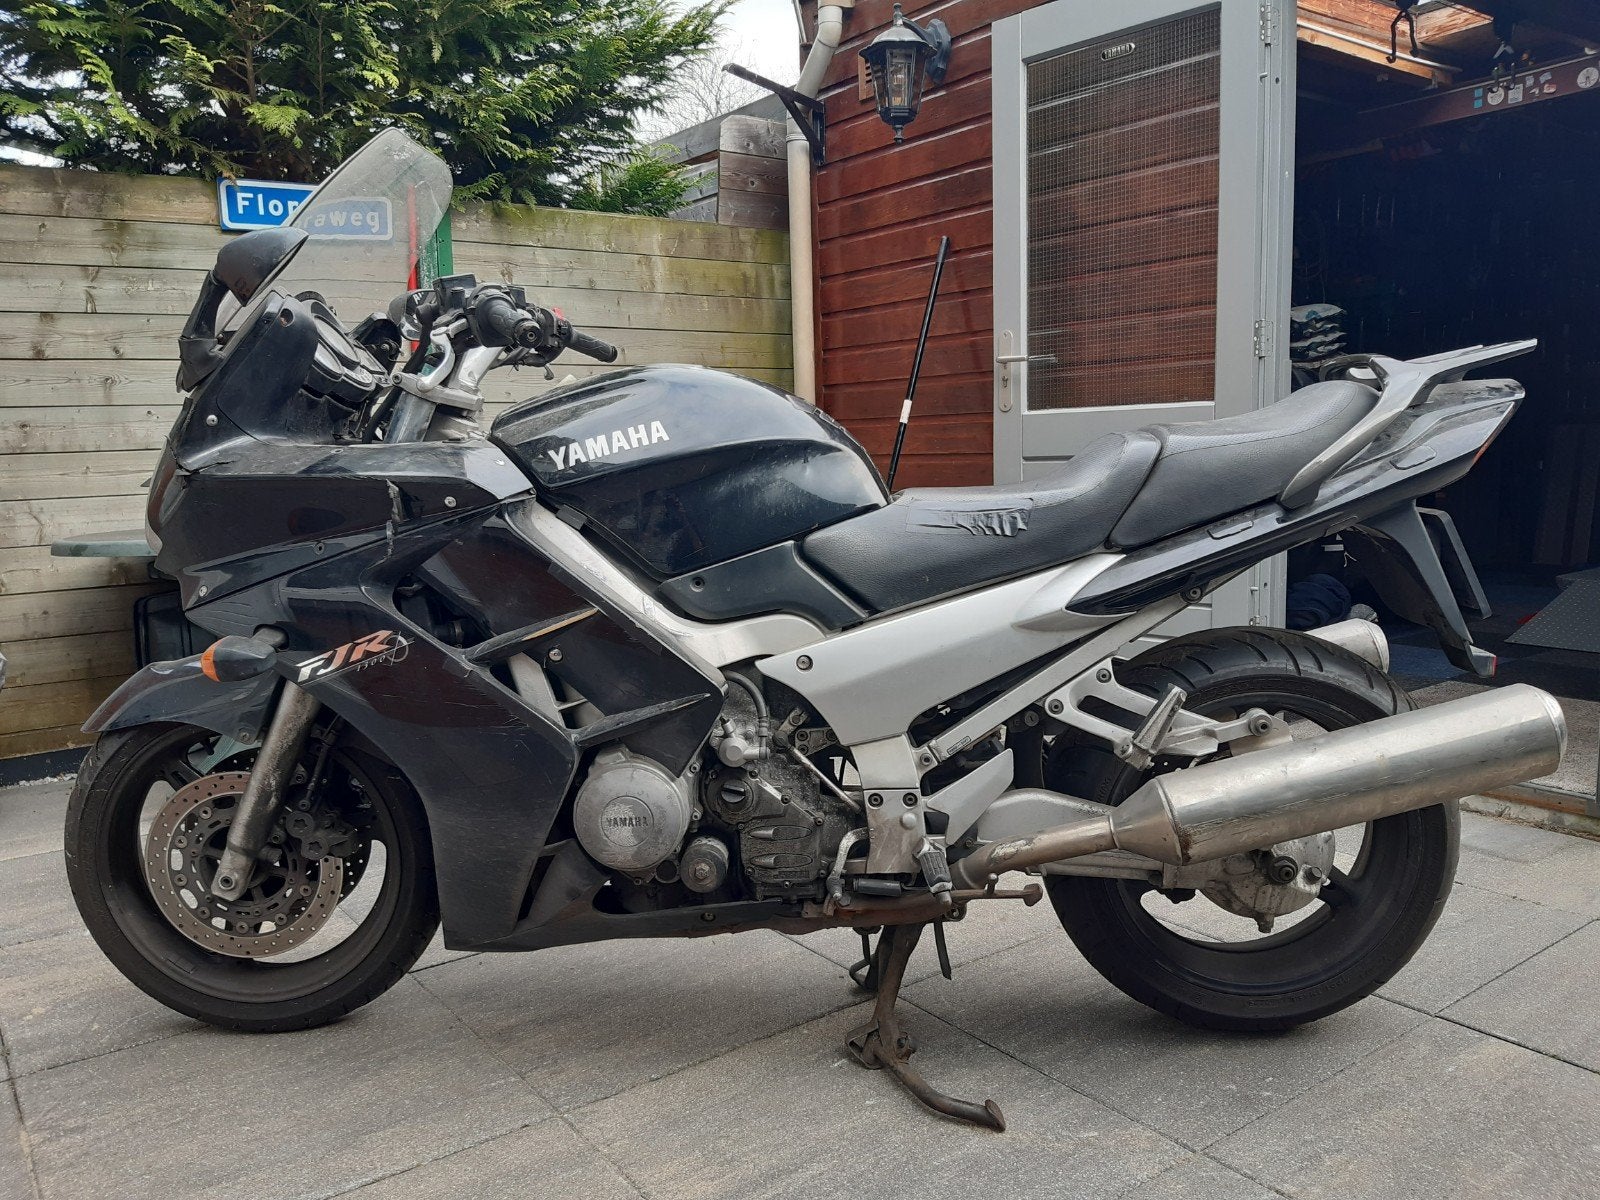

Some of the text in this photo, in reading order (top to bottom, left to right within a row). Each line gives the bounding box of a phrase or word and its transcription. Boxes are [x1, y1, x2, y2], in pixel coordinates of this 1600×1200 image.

[547, 420, 670, 471] YAMAHA
[295, 629, 393, 683] FJR
[606, 816, 648, 827] YAMAHA
